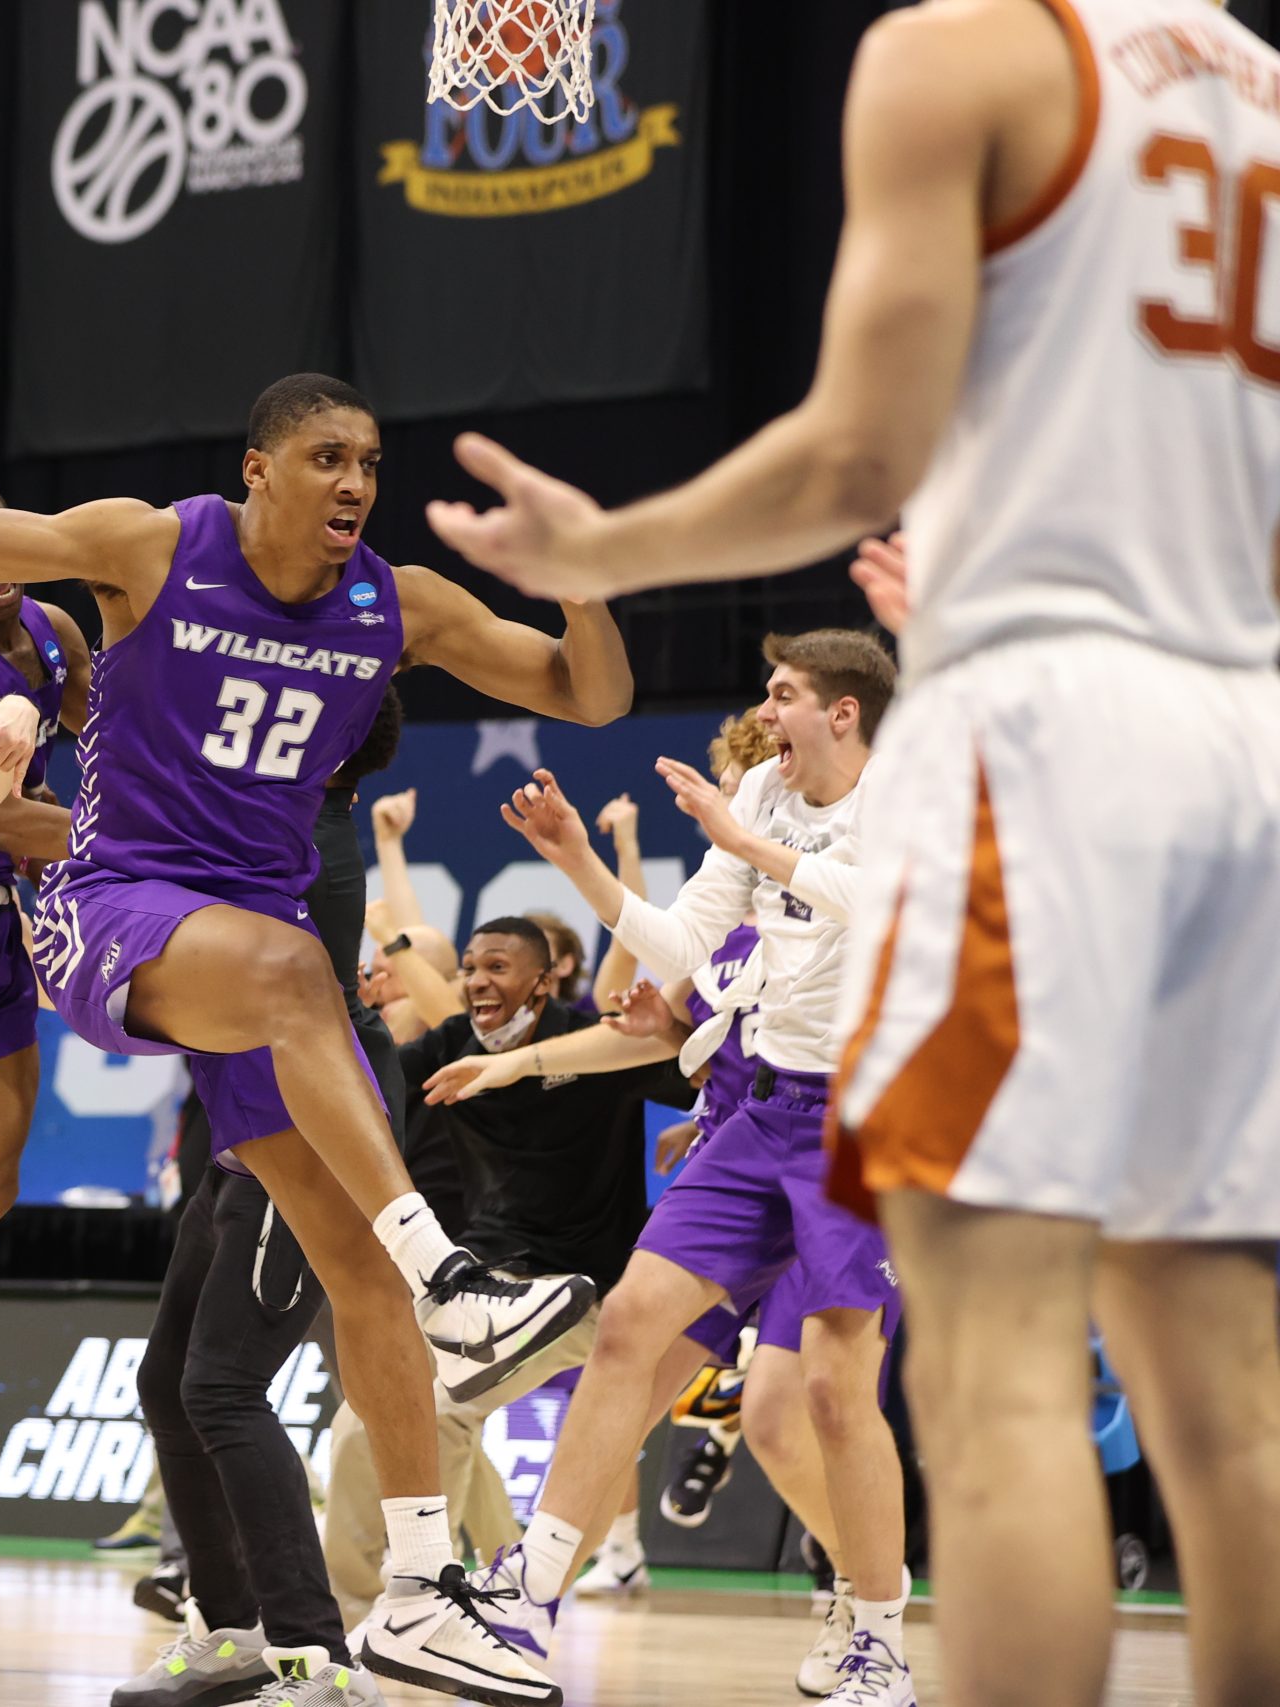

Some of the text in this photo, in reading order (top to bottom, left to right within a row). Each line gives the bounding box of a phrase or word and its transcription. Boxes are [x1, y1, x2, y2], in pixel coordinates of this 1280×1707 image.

[76, 0, 294, 86] NCAA
[171, 617, 382, 680] WILDCATS
[201, 676, 324, 779] 32
[101, 936, 122, 986] ACU
